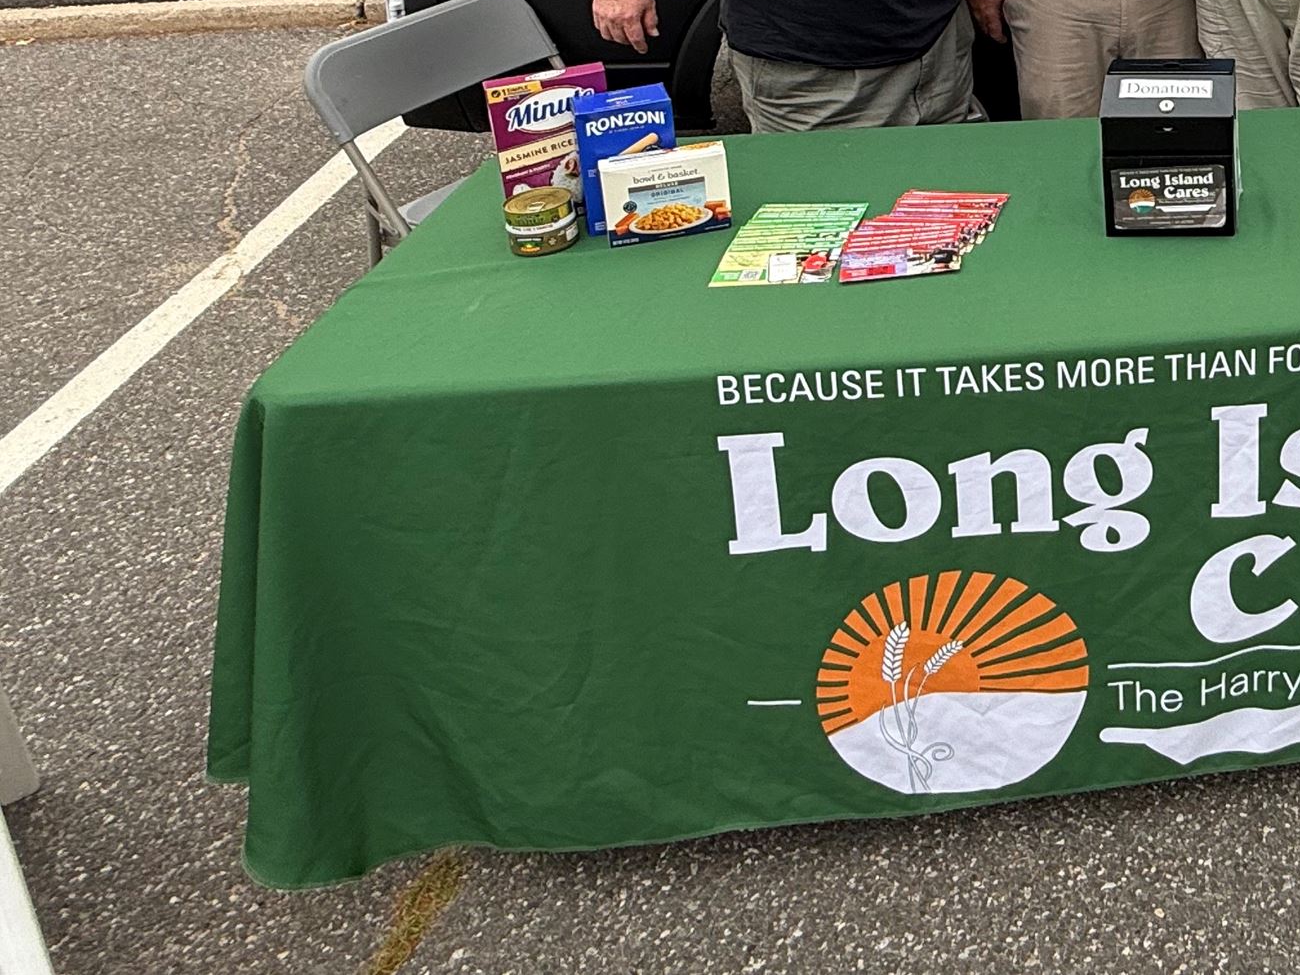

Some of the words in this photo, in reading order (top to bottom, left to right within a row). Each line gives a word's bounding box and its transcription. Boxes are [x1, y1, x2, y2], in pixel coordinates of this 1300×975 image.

[1126, 82, 1209, 95] Donations
[585, 110, 666, 137] RONZONI
[505, 146, 549, 165] JASMINE
[550, 138, 574, 152] RICE
[632, 174, 656, 185] bowl
[667, 168, 699, 180] basket
[1119, 176, 1160, 189] Long
[1164, 172, 1214, 186] Island
[1163, 186, 1209, 199] Cares
[716, 369, 885, 405] BECAUSE
[897, 368, 927, 397] IT
[936, 362, 1046, 395] TAKES
[1056, 358, 1155, 389] MORE
[1165, 348, 1257, 382] THAN
[716, 427, 1155, 555] Long
[1107, 681, 1185, 714] The
